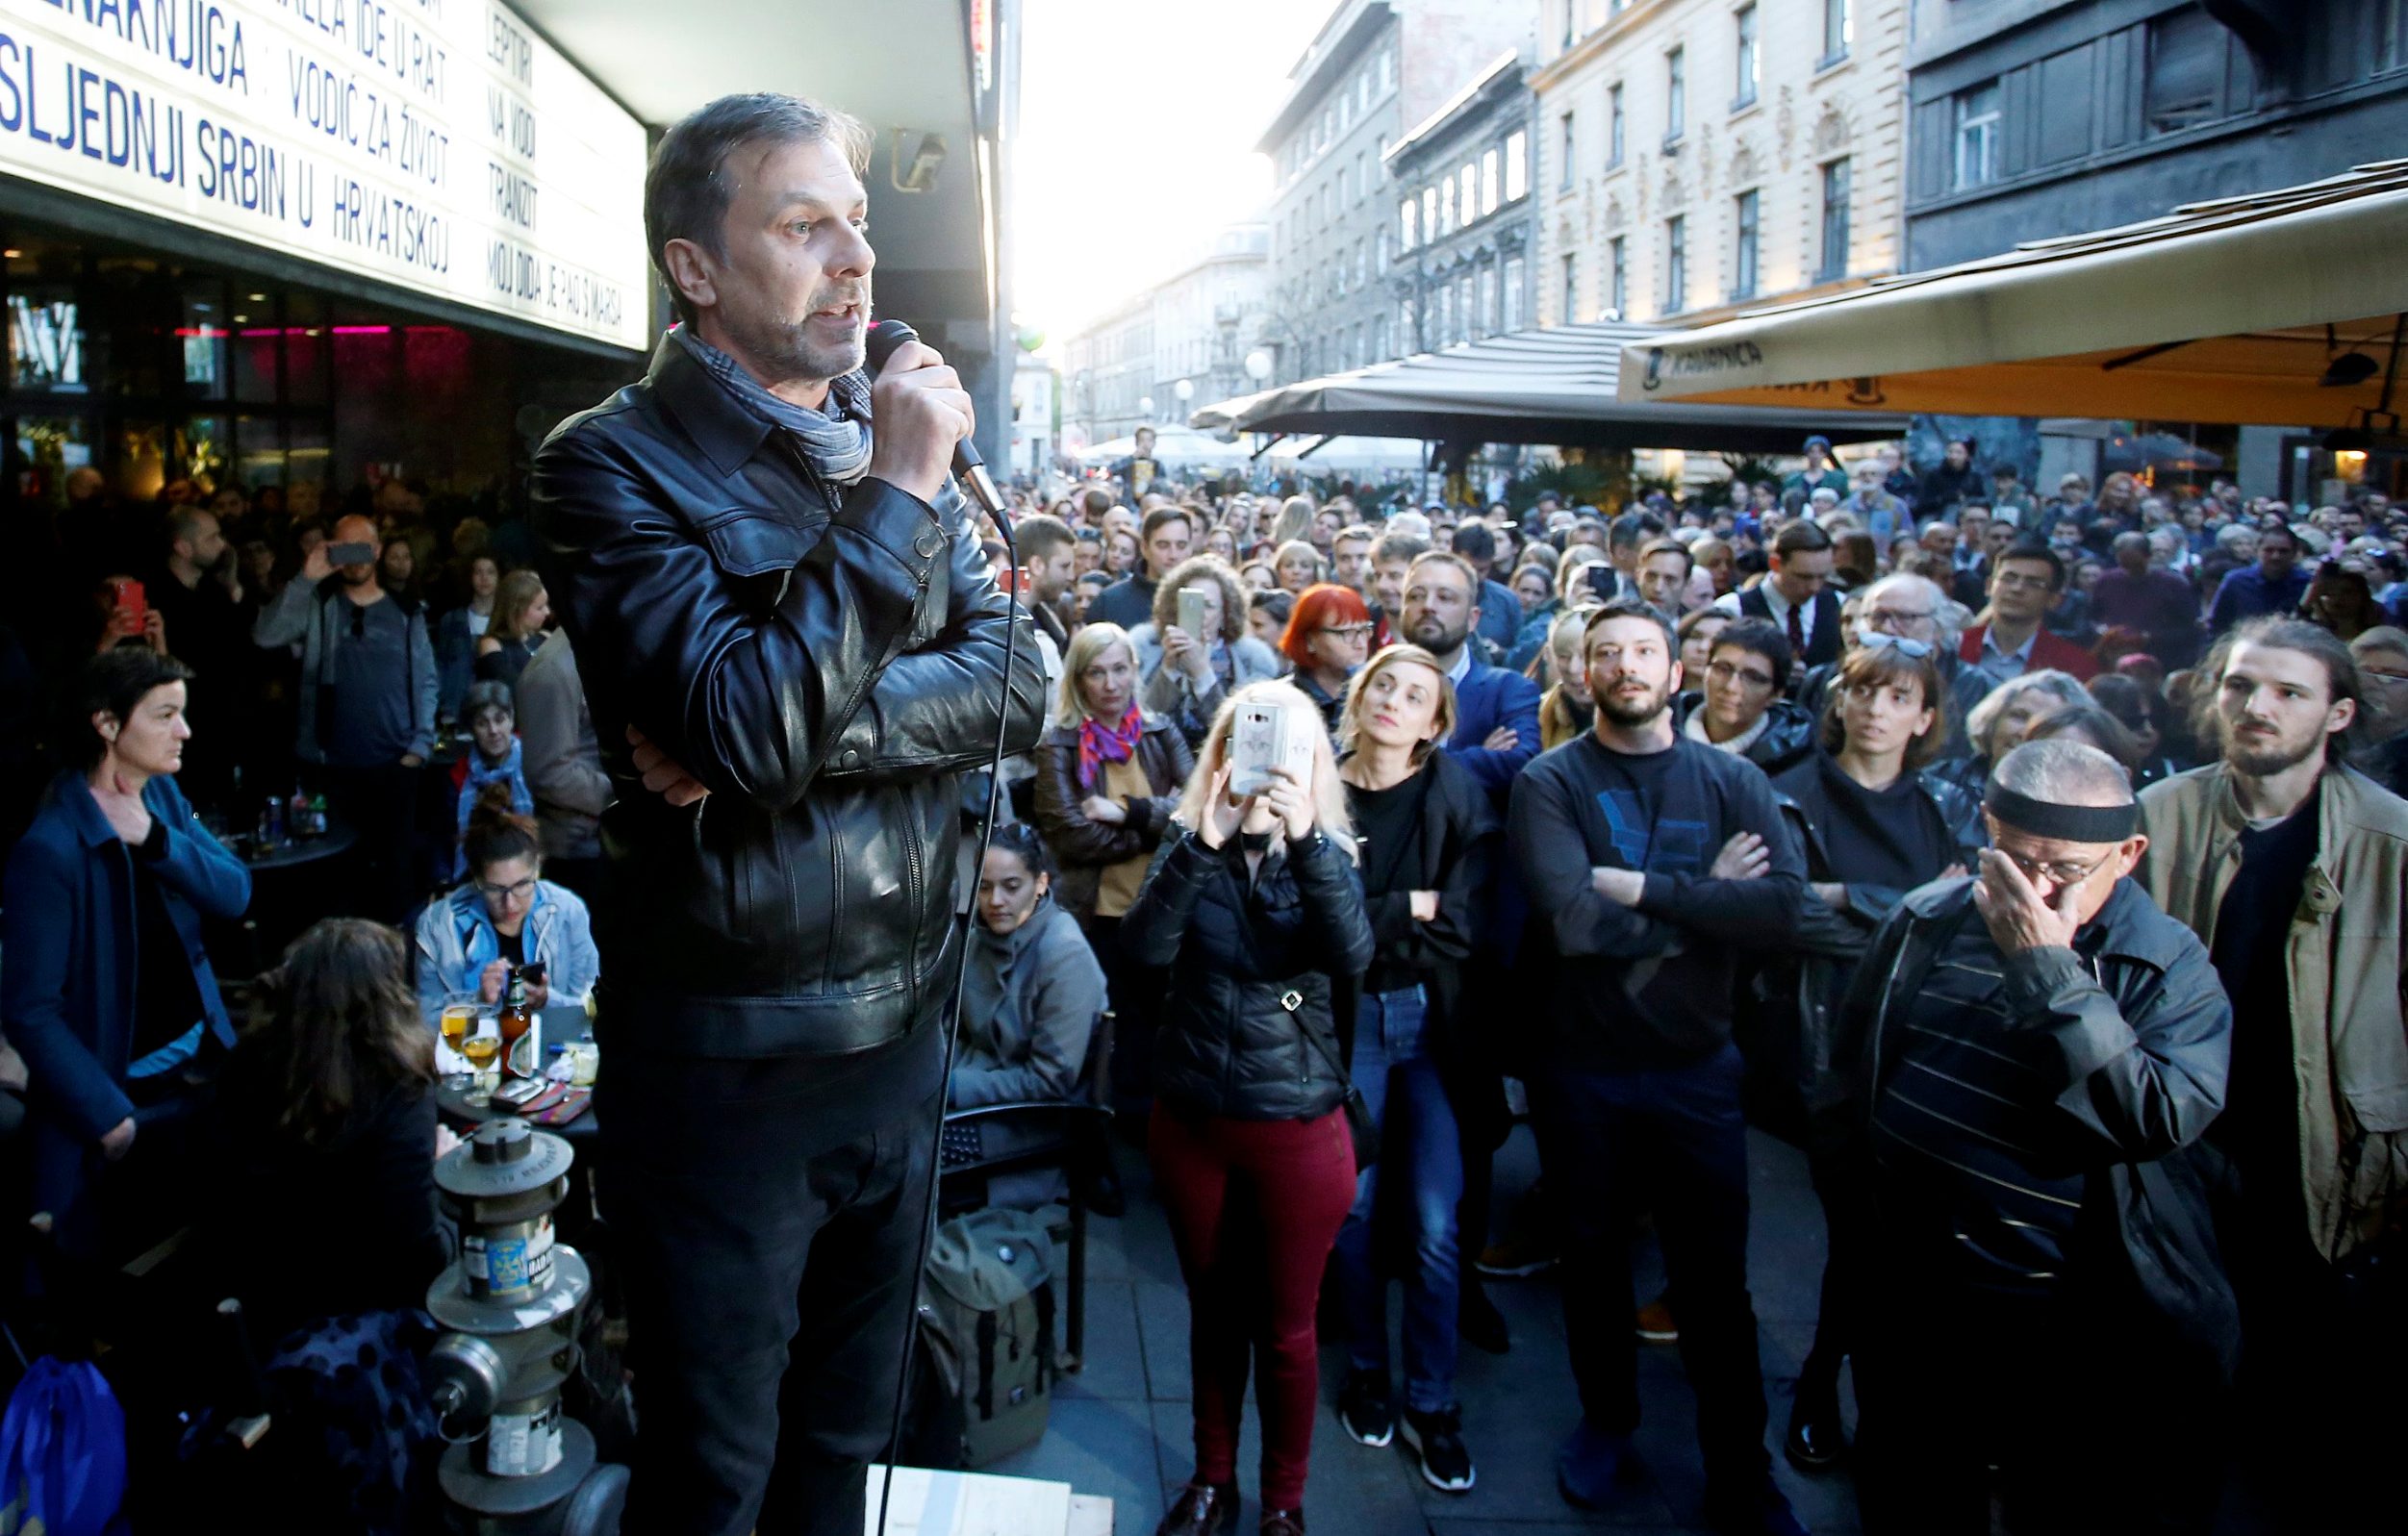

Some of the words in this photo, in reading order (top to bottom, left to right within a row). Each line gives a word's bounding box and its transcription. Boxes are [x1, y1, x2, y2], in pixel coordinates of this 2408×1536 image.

[393, 16, 405, 79] U
[413, 32, 445, 105] RAT
[0, 33, 185, 188] SLJEDNJI
[198, 119, 286, 220] SRBIN
[298, 159, 314, 228] U
[333, 173, 448, 274] HRVATSKOJ
[368, 93, 392, 164] ZA
